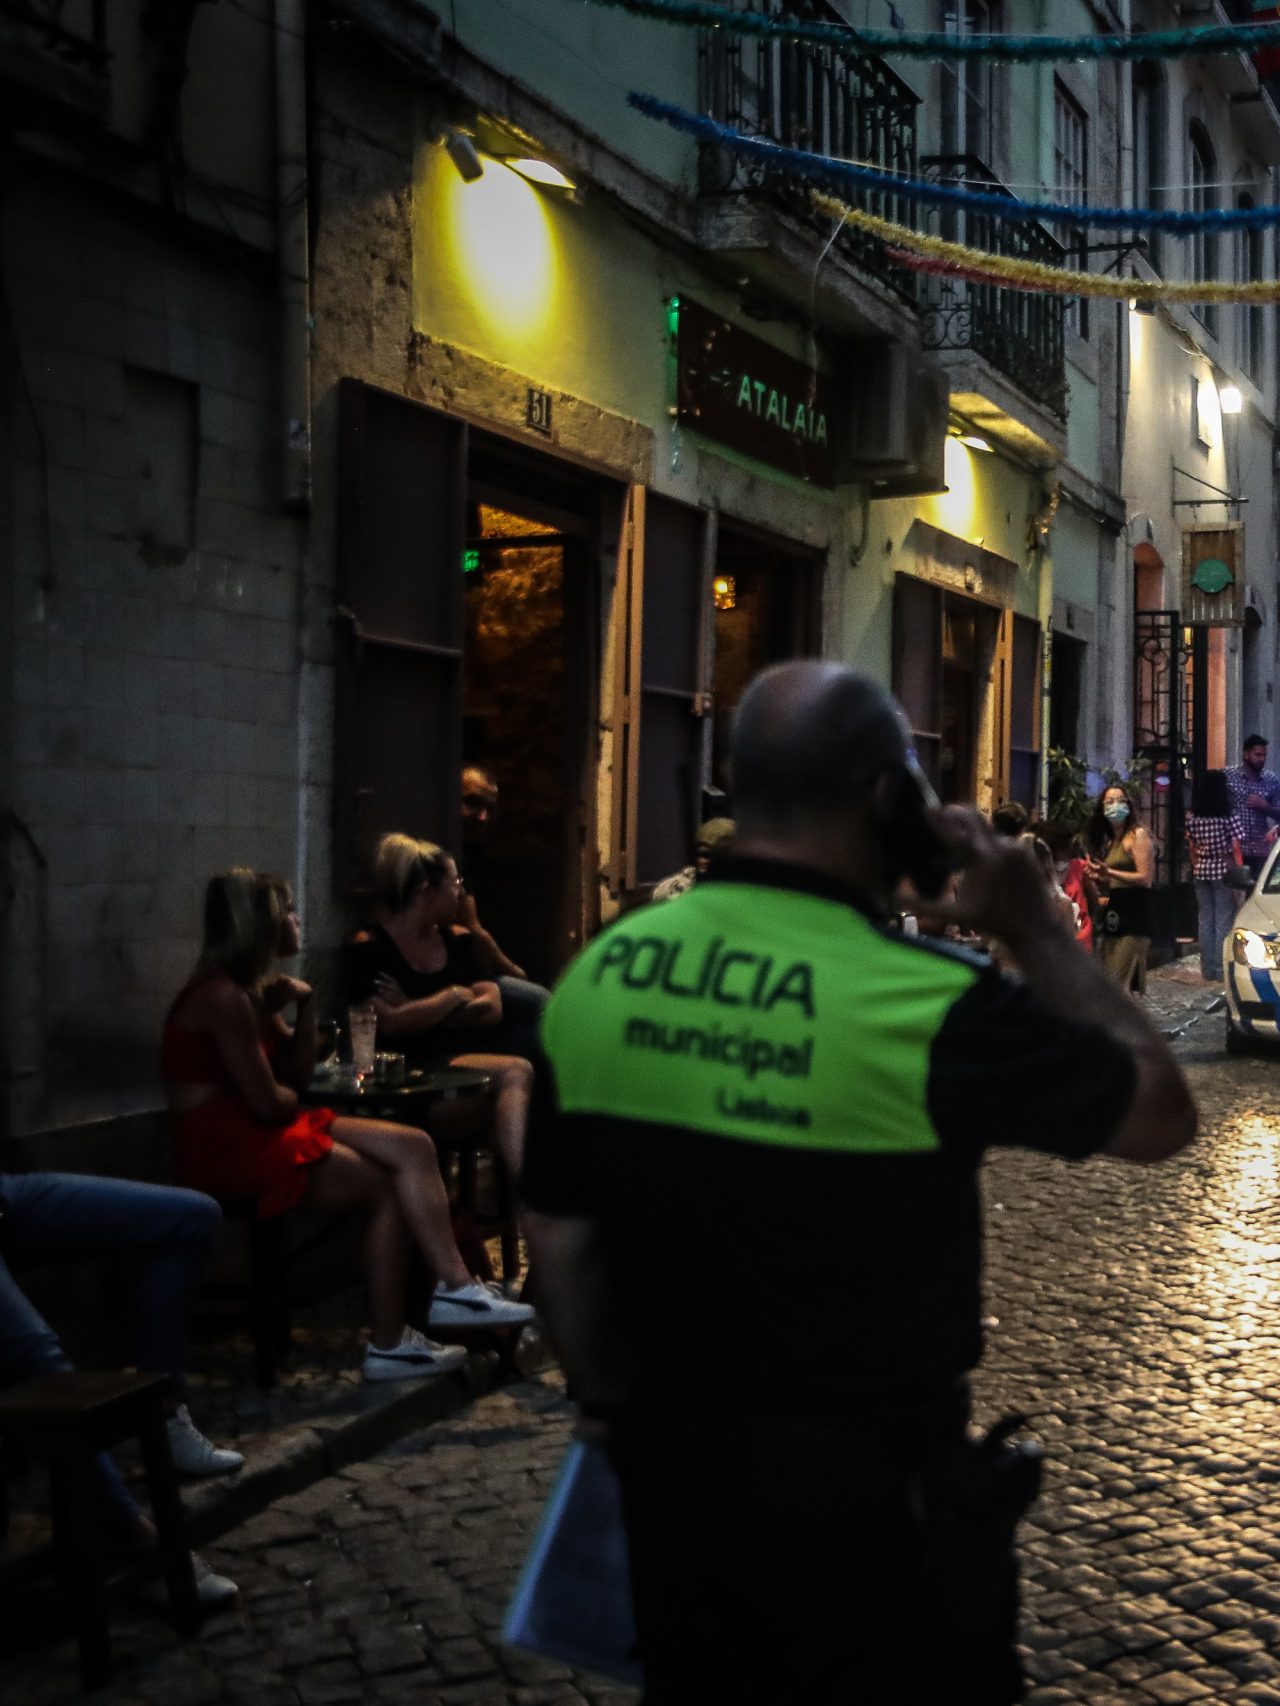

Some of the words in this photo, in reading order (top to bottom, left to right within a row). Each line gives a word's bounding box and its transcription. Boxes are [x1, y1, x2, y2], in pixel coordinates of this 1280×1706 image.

[531, 390, 548, 427] 51
[736, 373, 828, 448] ATALAIA
[592, 933, 816, 1018] POLÍCIA
[626, 1016, 814, 1079] municipal
[716, 1088, 811, 1129] Lisboa
